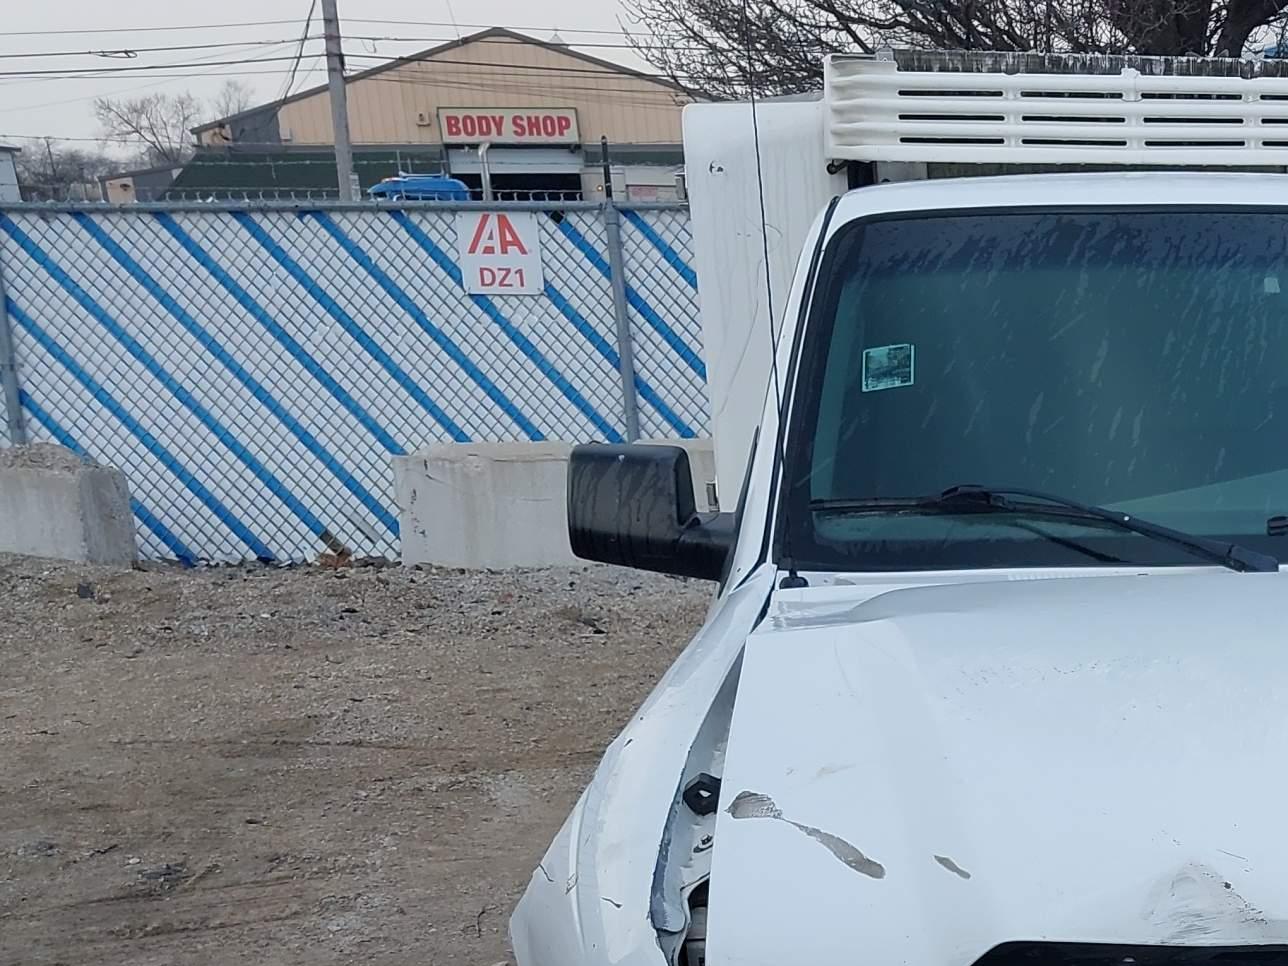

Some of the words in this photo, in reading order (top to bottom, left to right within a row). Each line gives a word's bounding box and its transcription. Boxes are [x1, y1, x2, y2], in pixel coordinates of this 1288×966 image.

[446, 115, 504, 137] BODY
[512, 115, 571, 137] SHOP
[479, 267, 525, 287] DZ1
